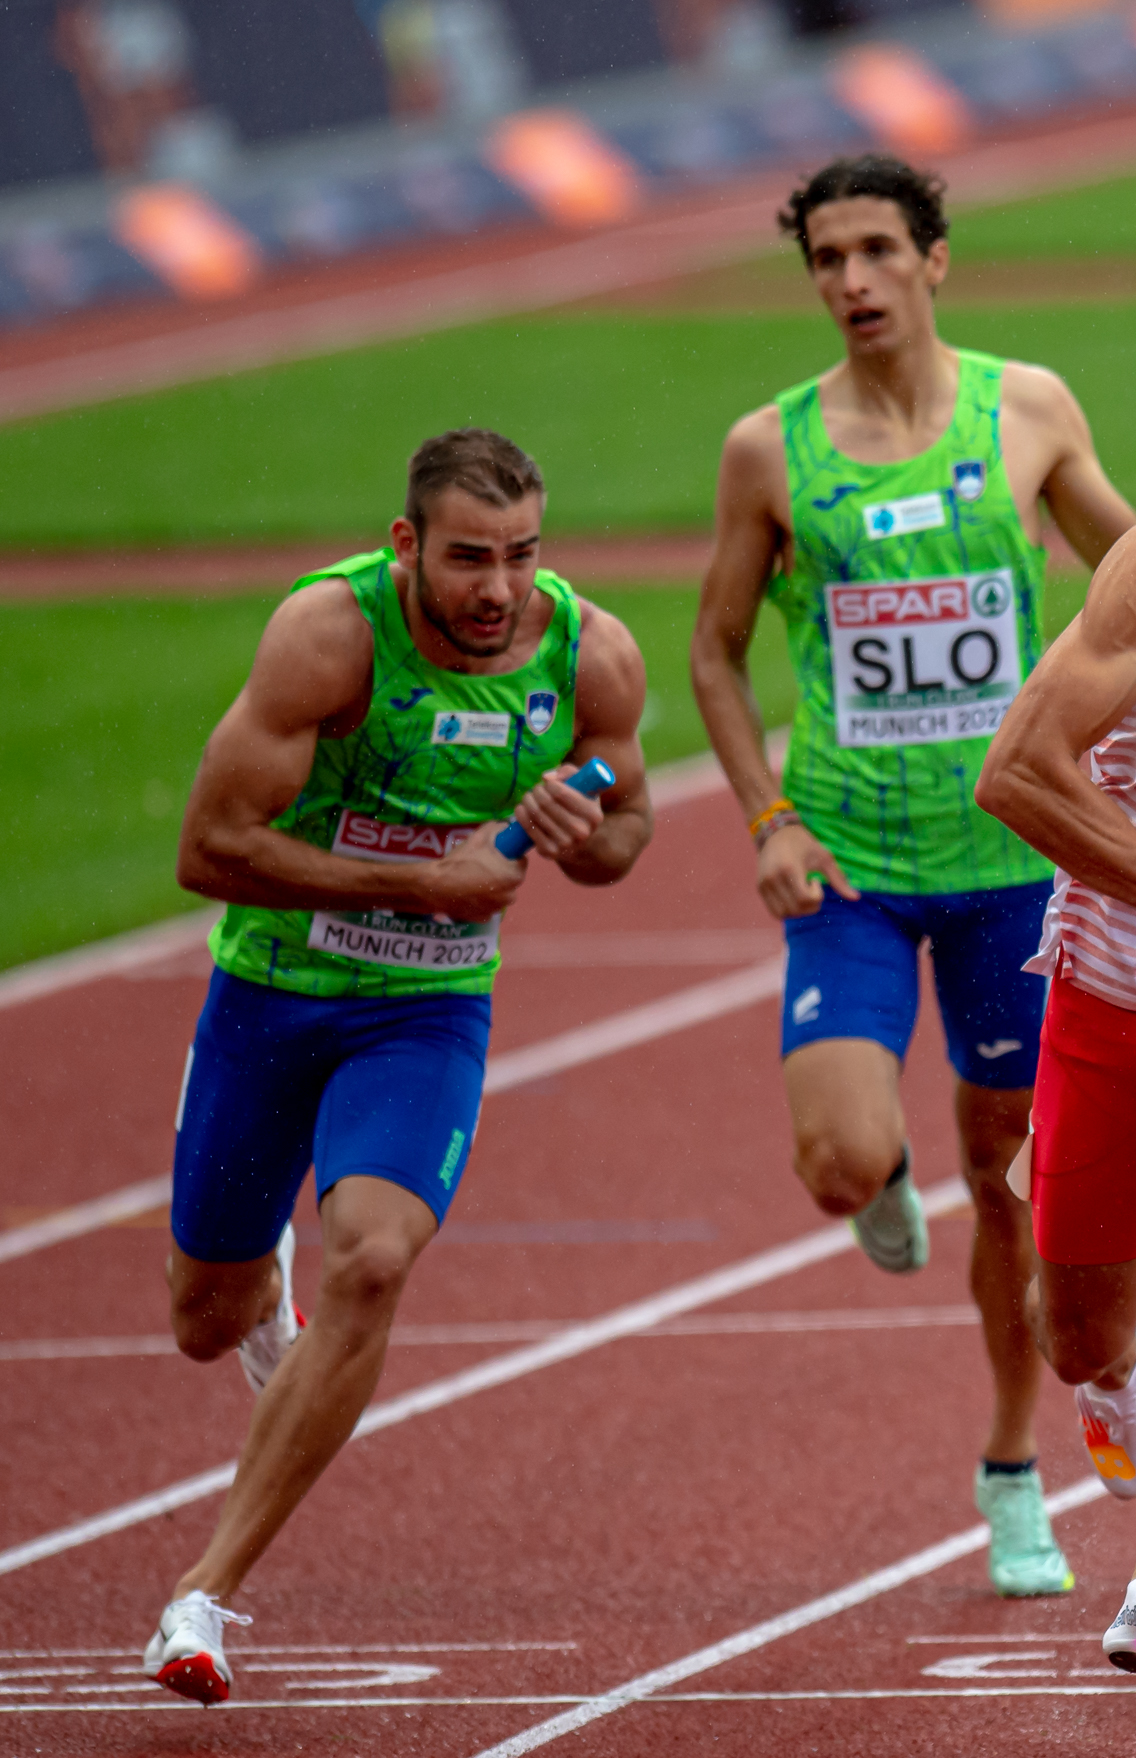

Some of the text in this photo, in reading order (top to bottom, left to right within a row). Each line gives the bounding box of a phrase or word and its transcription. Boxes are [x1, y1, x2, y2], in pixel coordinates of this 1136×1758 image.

[836, 586, 966, 622] SPAR
[852, 630, 1001, 693] SLO
[850, 714, 949, 739] MUNICH
[323, 925, 488, 965] MUNICH 2022
